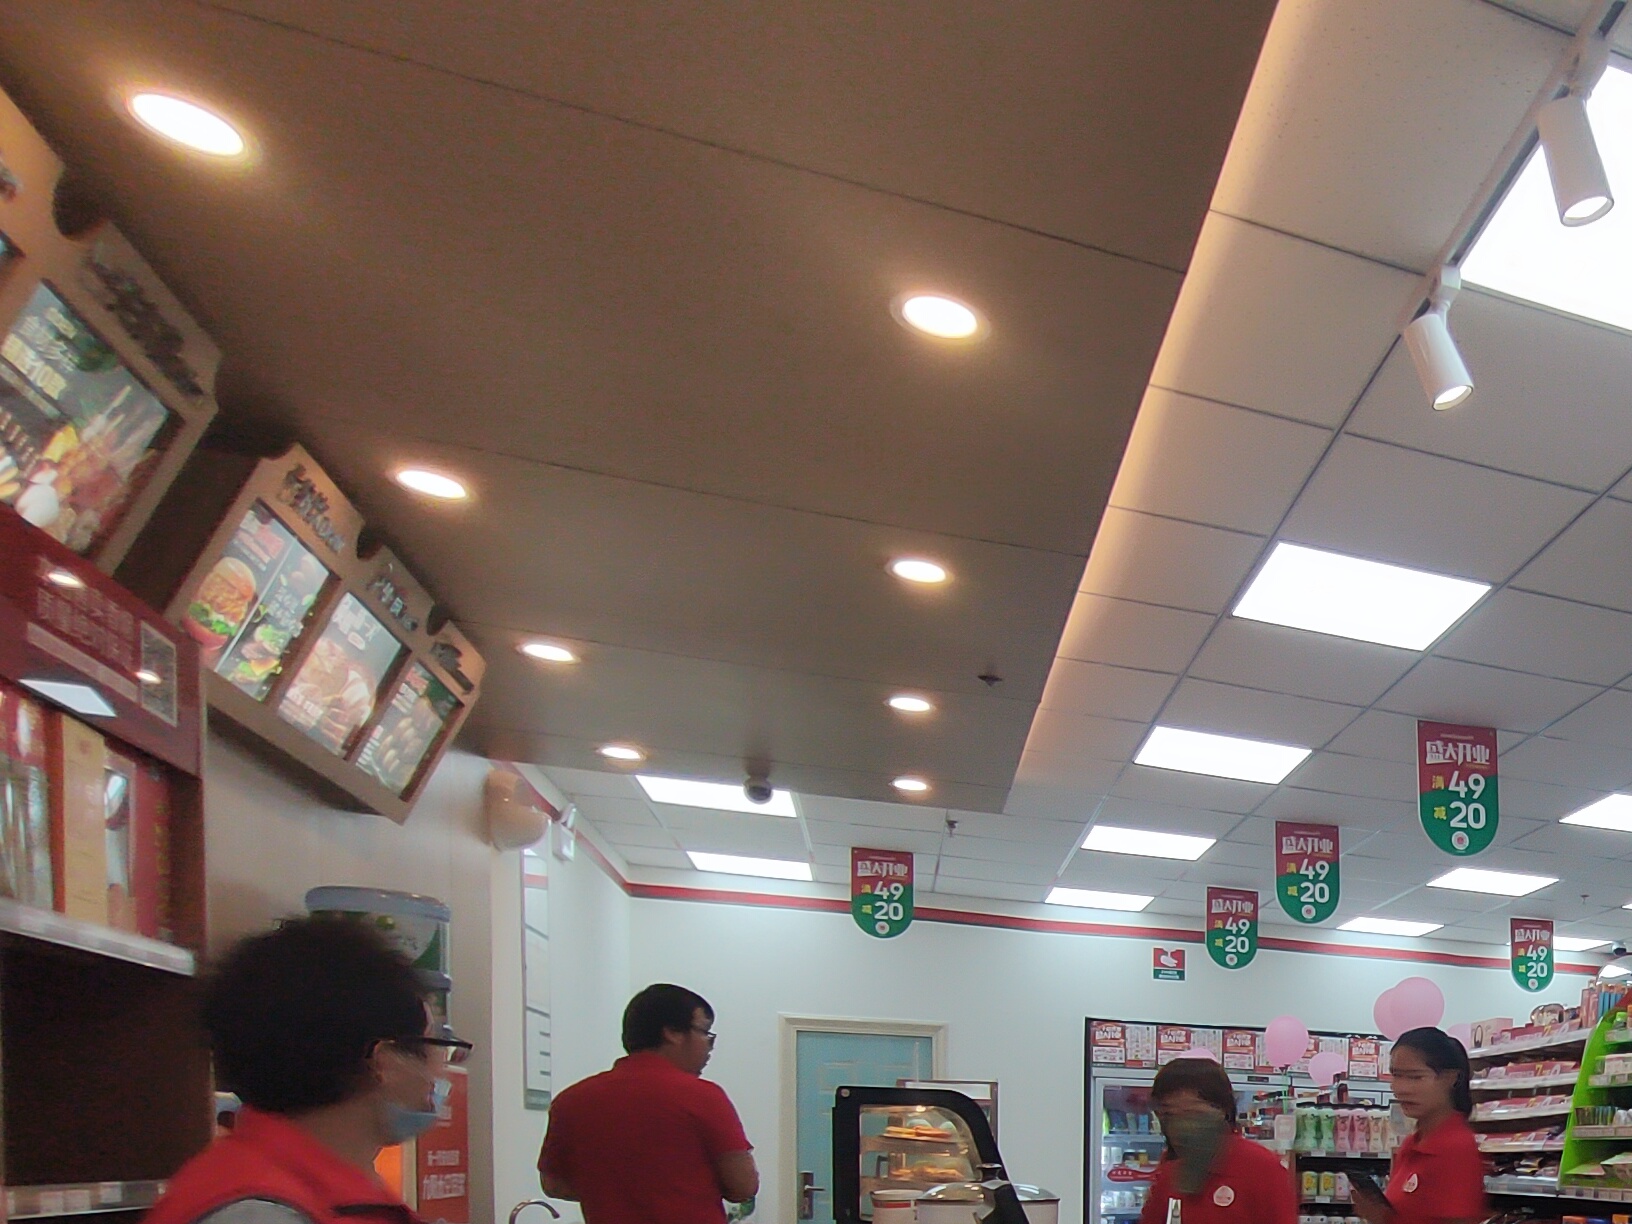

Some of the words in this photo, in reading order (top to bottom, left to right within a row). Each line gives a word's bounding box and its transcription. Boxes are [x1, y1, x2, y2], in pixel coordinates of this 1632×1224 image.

[1426, 740, 1490, 766] 盛大开业
[1448, 770, 1486, 799] 49
[1449, 801, 1486, 829] 20
[1300, 859, 1329, 881] 49
[873, 881, 904, 900] 49
[1300, 882, 1330, 903] 20
[874, 901, 904, 920] 20
[1225, 917, 1250, 935] 49
[1225, 935, 1249, 953] 20
[1527, 945, 1548, 961] 49
[1527, 962, 1548, 978] 20
